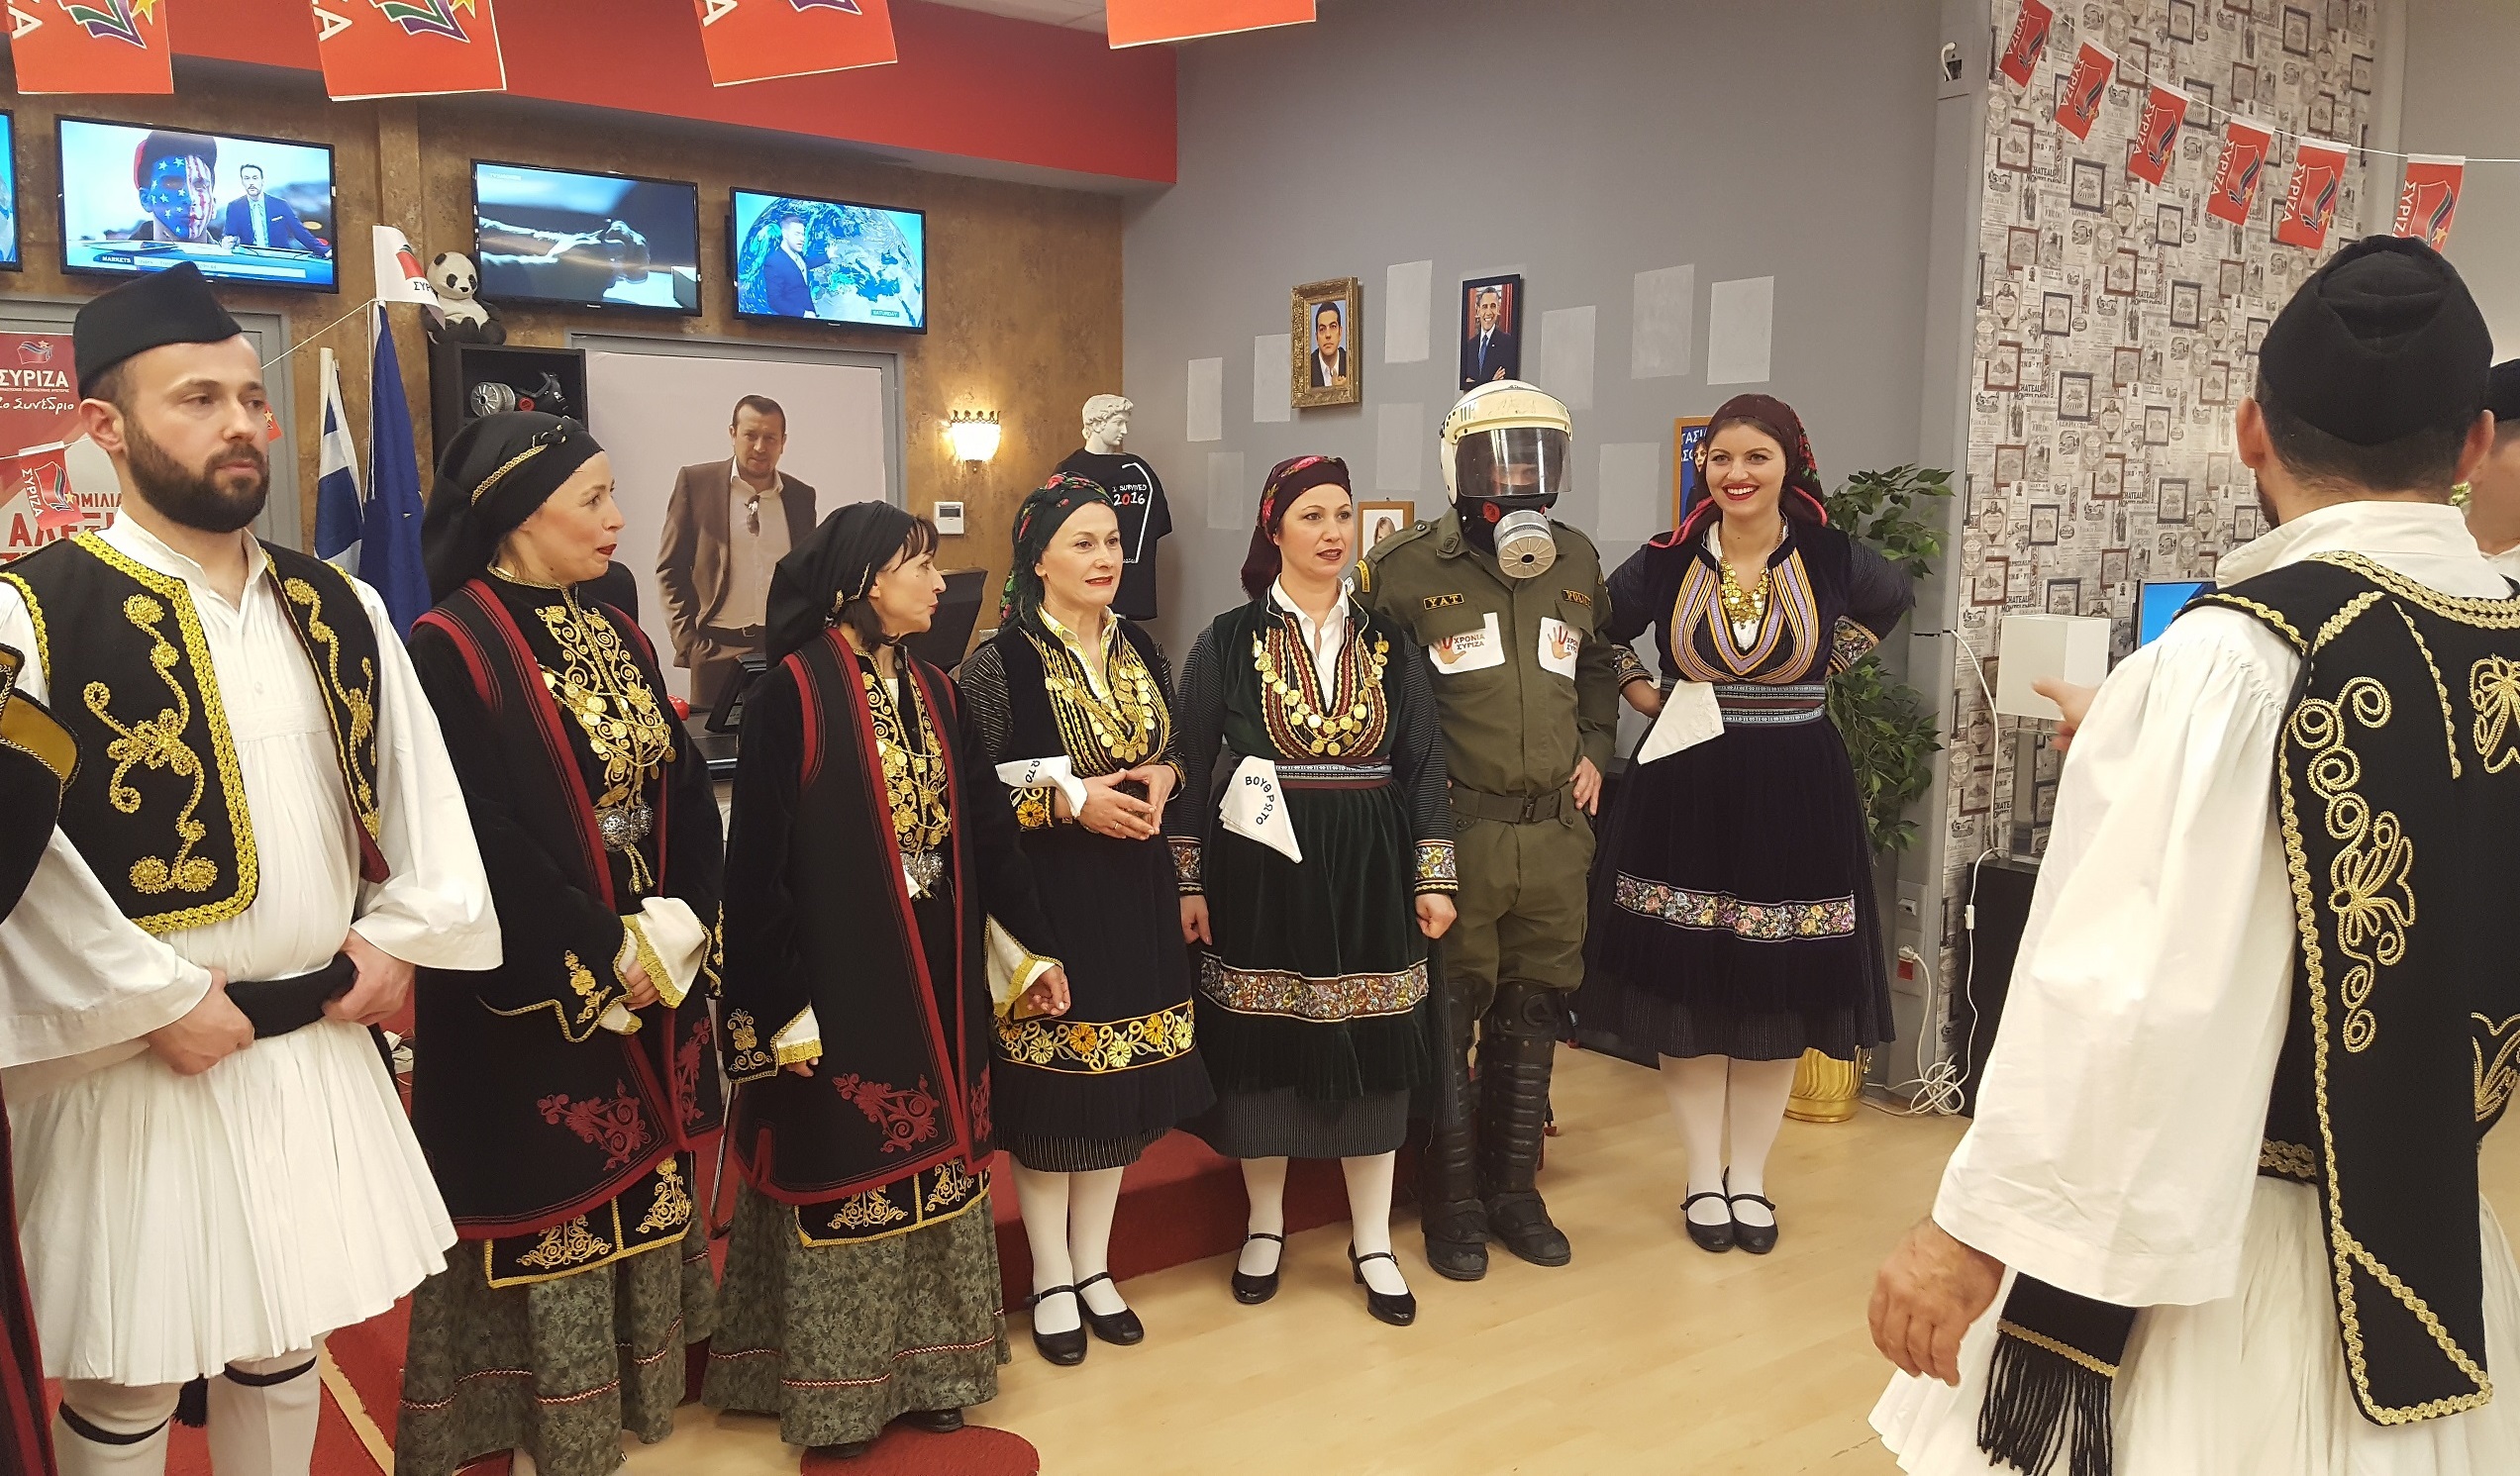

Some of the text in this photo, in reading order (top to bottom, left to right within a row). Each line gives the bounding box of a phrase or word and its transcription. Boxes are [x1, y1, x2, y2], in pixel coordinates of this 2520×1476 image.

[2005, 9, 2028, 54] ΣΥΡΙΖΑ
[2060, 58, 2085, 106] ΣΥΡΙΖΑ
[2134, 100, 2157, 154] ΣΥΡΙΖΑ
[2210, 139, 2236, 195] ΣΥΡΙΖΑ
[2281, 162, 2306, 222] ΣΥΡΙΖΑ
[2392, 180, 2417, 238] ΣΥΡΙΖ
[101, 254, 132, 264] MARKETS
[413, 281, 434, 292] ΣΥΡ
[0, 369, 69, 387] ΣΥΡΙΖΑ
[22, 467, 45, 518] ΣΥΡΙΖΑ
[1113, 491, 1146, 506] 2016
[1454, 634, 1486, 644] ΧΡΟΝΙΑ
[1457, 641, 1485, 650] ΣΥΡΙΖΑ
